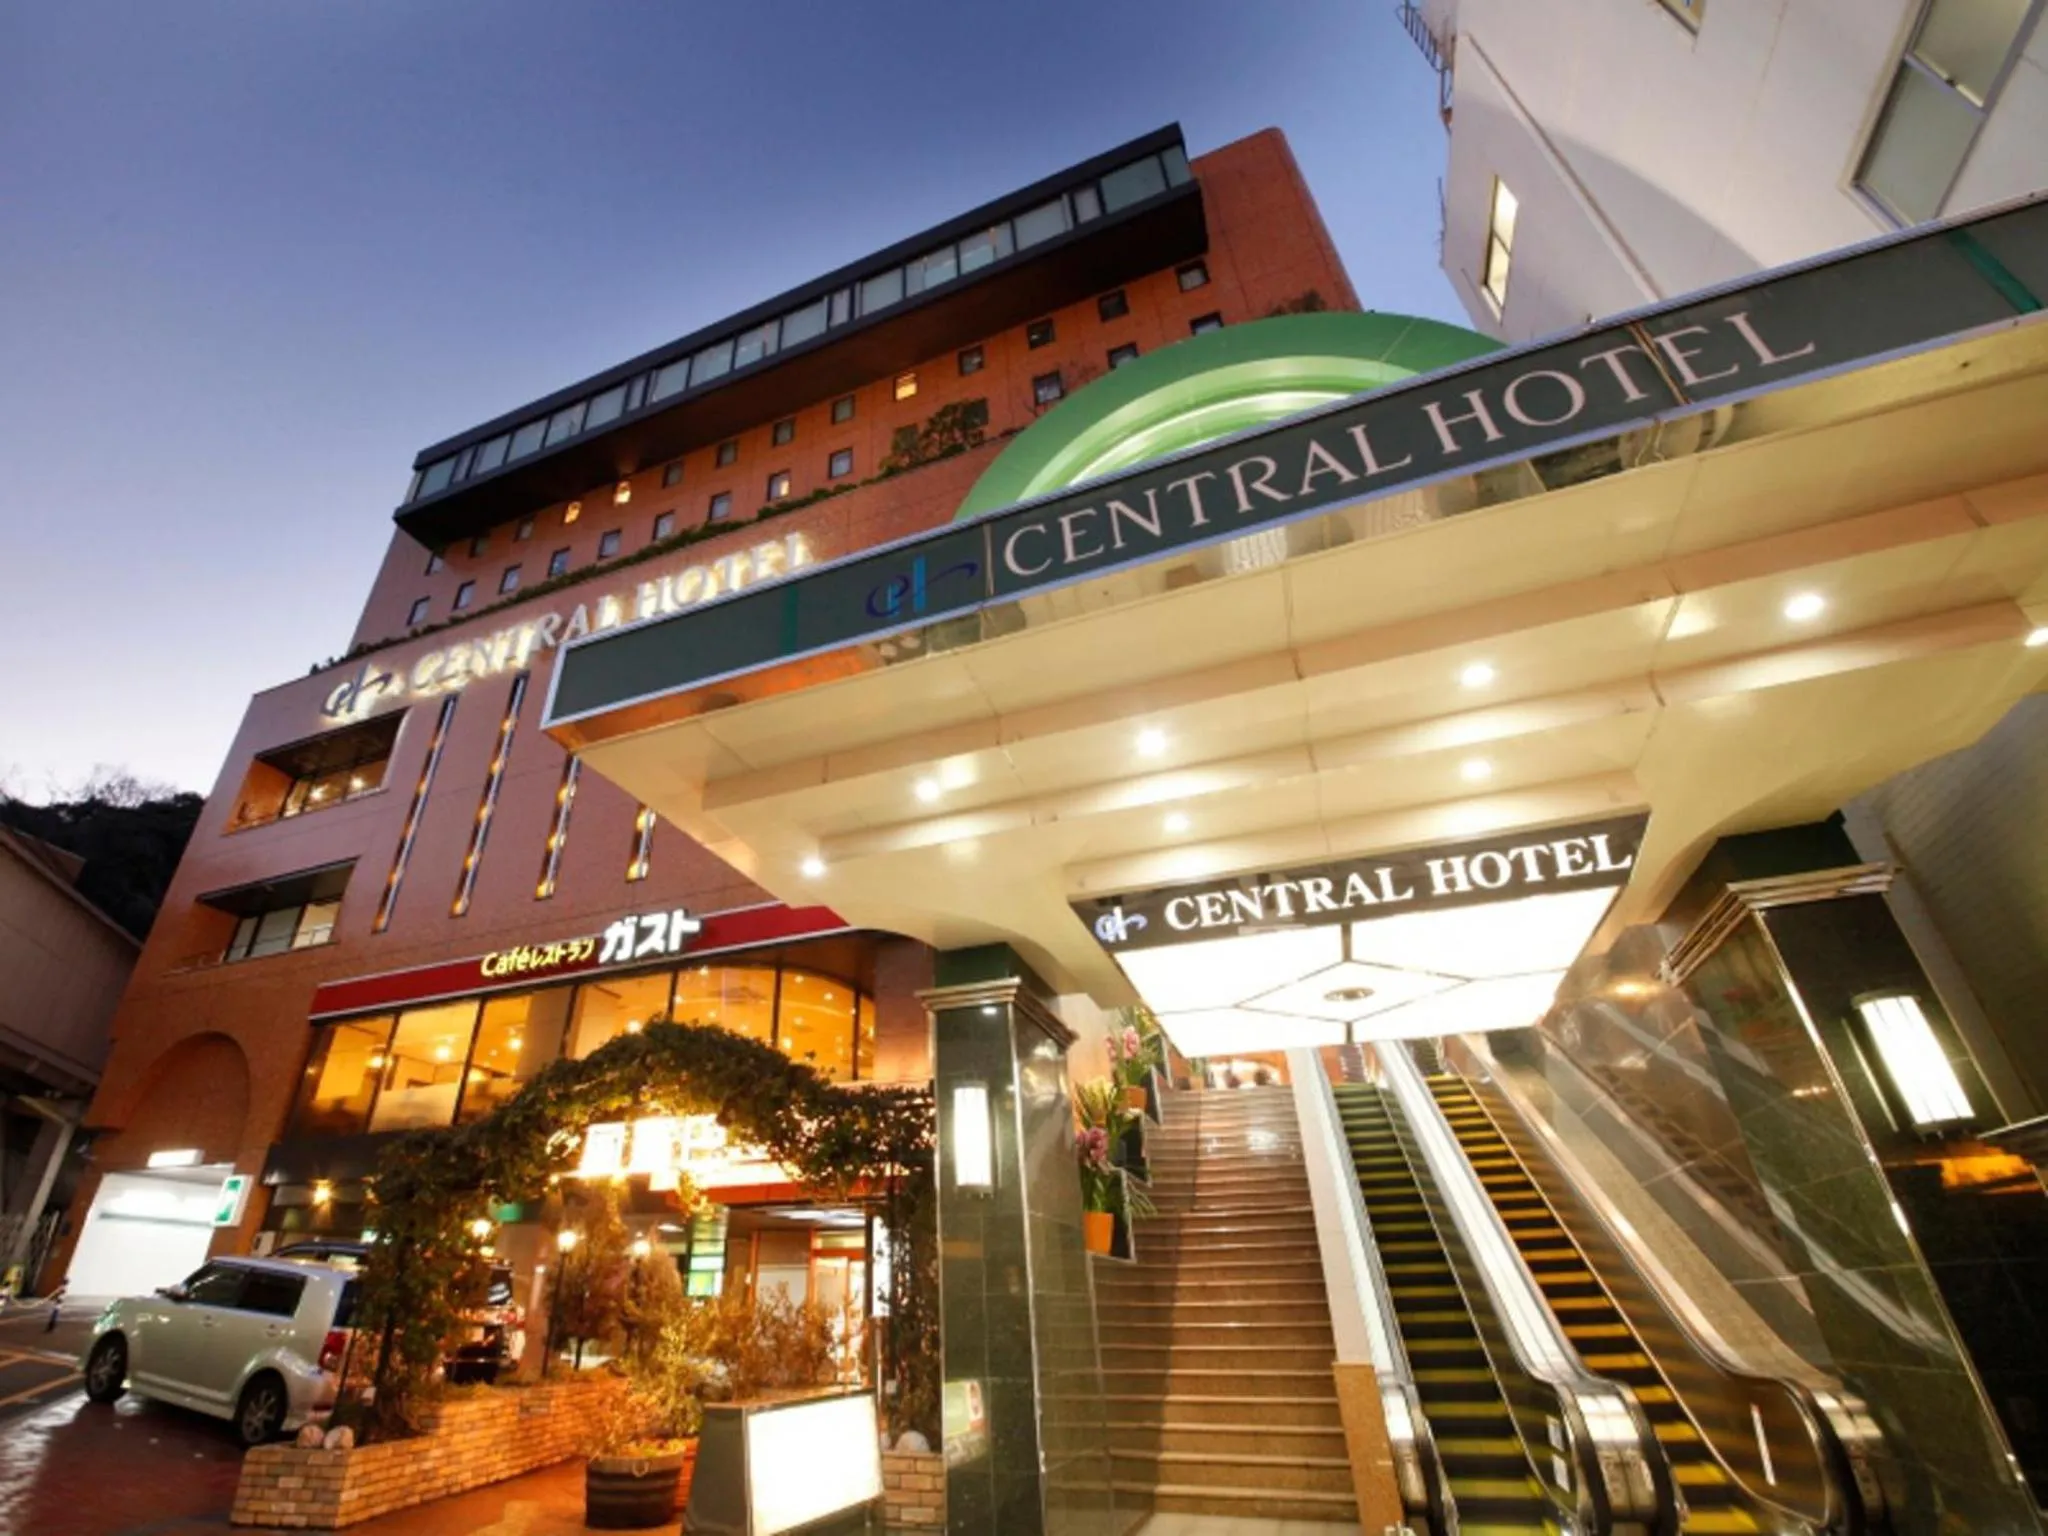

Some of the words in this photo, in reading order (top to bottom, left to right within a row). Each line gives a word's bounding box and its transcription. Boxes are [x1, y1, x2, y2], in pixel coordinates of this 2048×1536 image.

[1003, 422, 1413, 577] CENTRAL
[1422, 310, 1816, 455] HOTEL
[410, 594, 623, 690] CENTRAL
[636, 531, 816, 619] HOTEL
[598, 908, 701, 964] ガスト
[1163, 866, 1414, 931] CENTRAL
[1426, 833, 1632, 896] HOTEL
